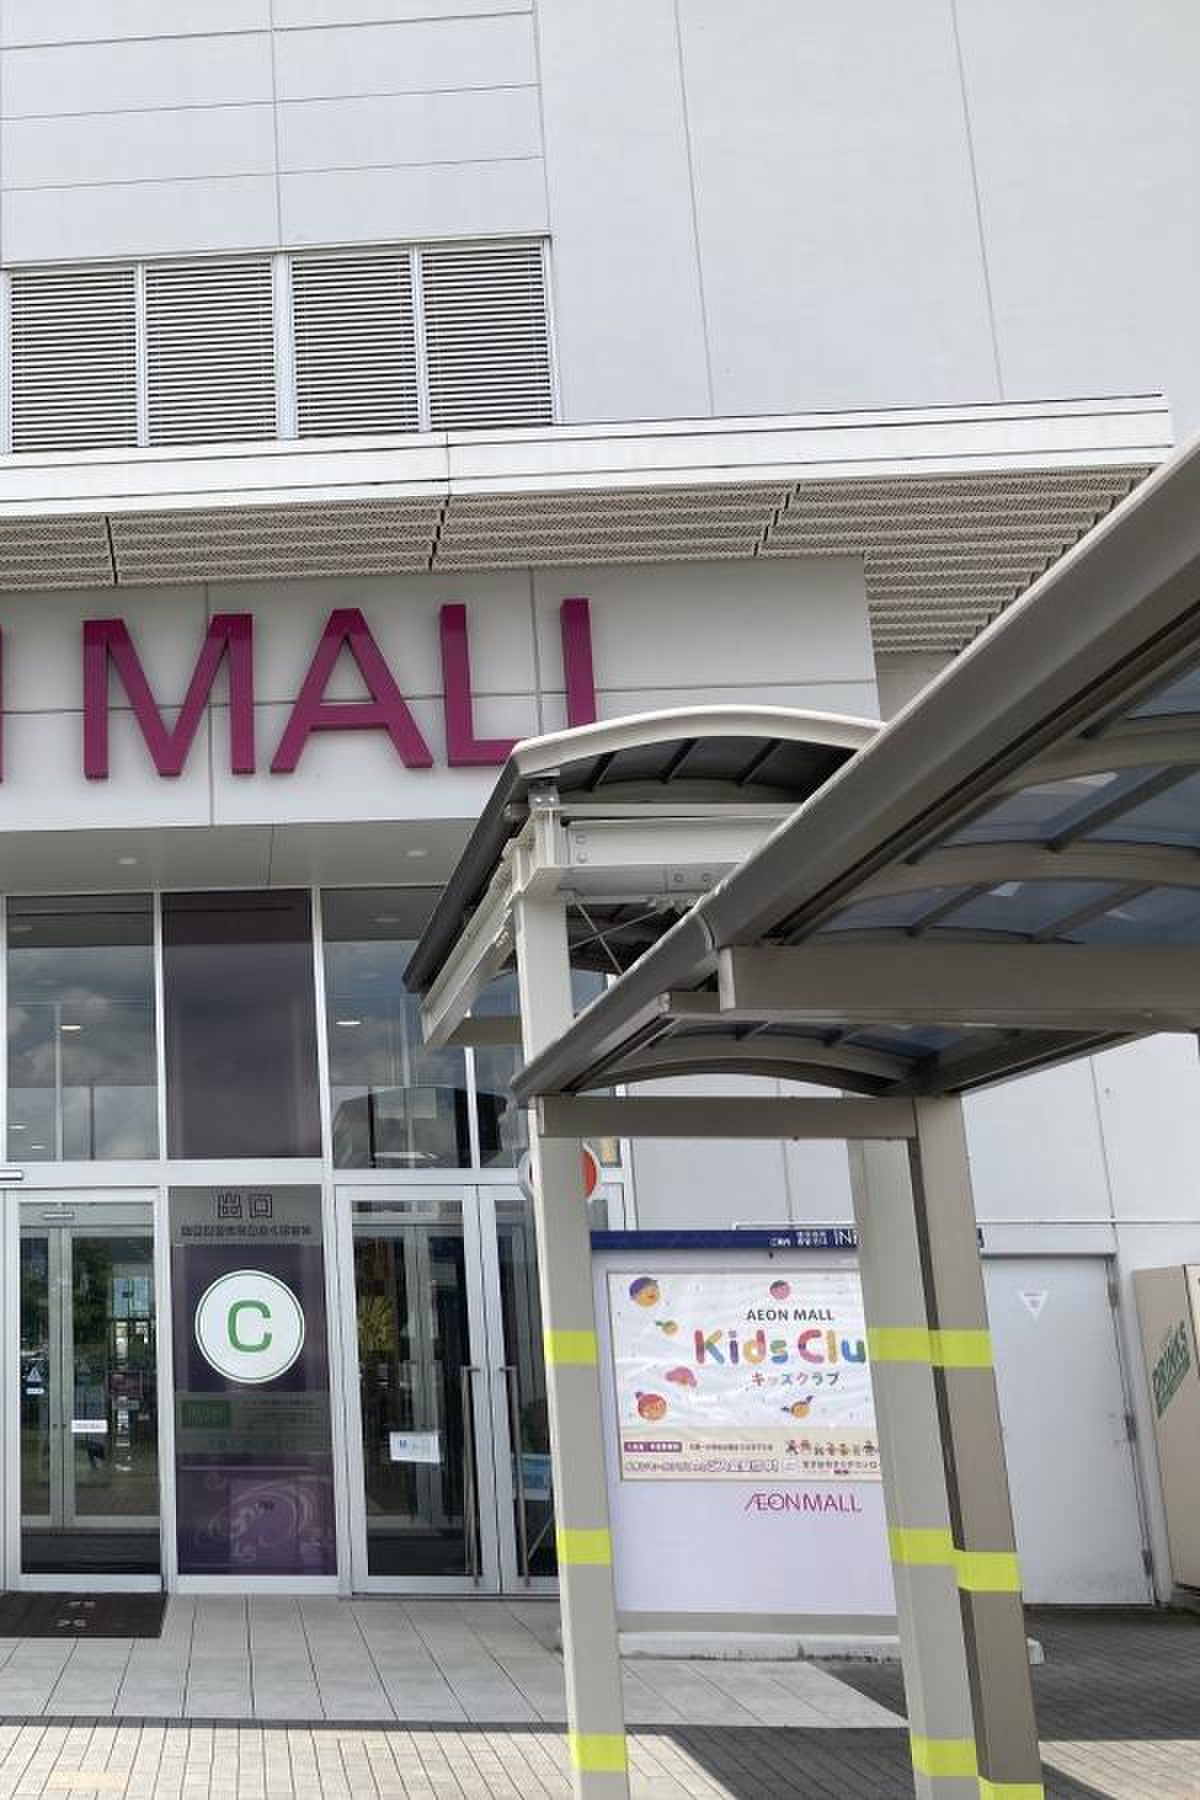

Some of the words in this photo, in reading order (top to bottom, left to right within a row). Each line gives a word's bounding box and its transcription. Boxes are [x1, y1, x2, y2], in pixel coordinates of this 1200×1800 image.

[217, 1192, 273, 1218] 出口
[227, 1300, 273, 1353] C
[746, 1309, 788, 1321] AEON
[793, 1308, 835, 1321] MALL
[694, 1329, 788, 1364] Kids
[798, 1328, 867, 1364] Clu
[751, 1371, 841, 1387] キッズクラブ
